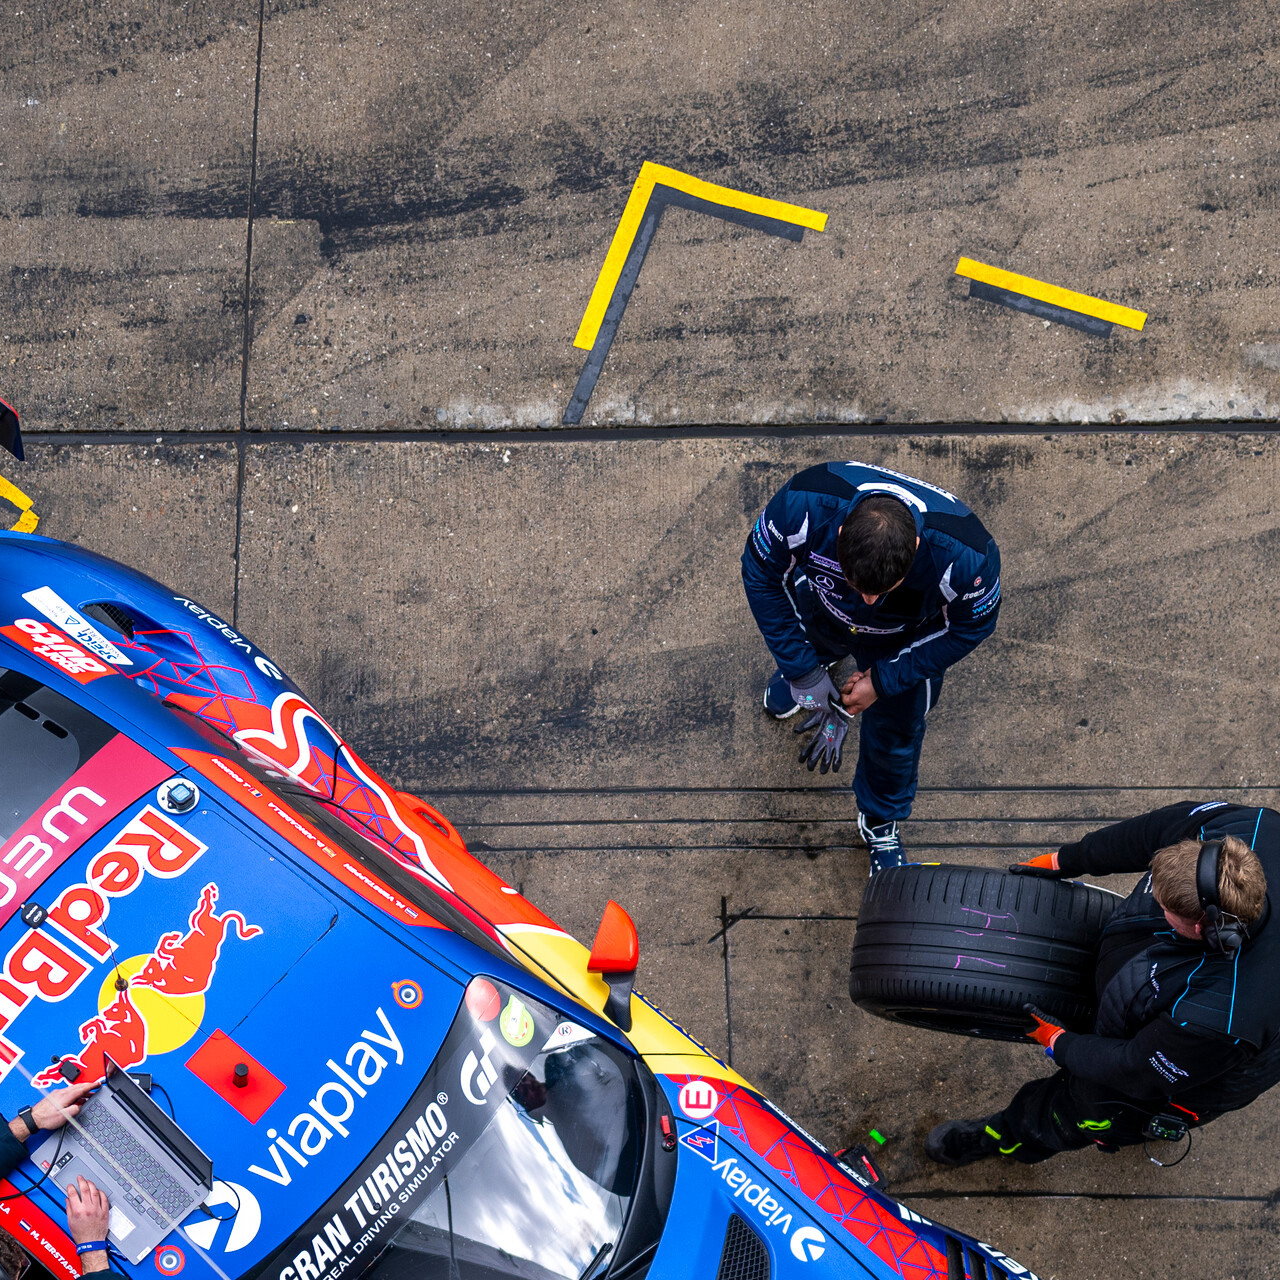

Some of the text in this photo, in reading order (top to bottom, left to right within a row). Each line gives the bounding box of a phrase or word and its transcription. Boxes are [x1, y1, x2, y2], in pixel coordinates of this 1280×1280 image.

[14, 618, 107, 673] auto
[173, 597, 252, 654] viaplay
[33, 646, 86, 674] sport
[247, 1006, 405, 1187] viaplay
[685, 1089, 712, 1109] E
[352, 1203, 401, 1255] DRIVING
[400, 1131, 460, 1204] SIMULATOR
[712, 1157, 793, 1235] viaplay
